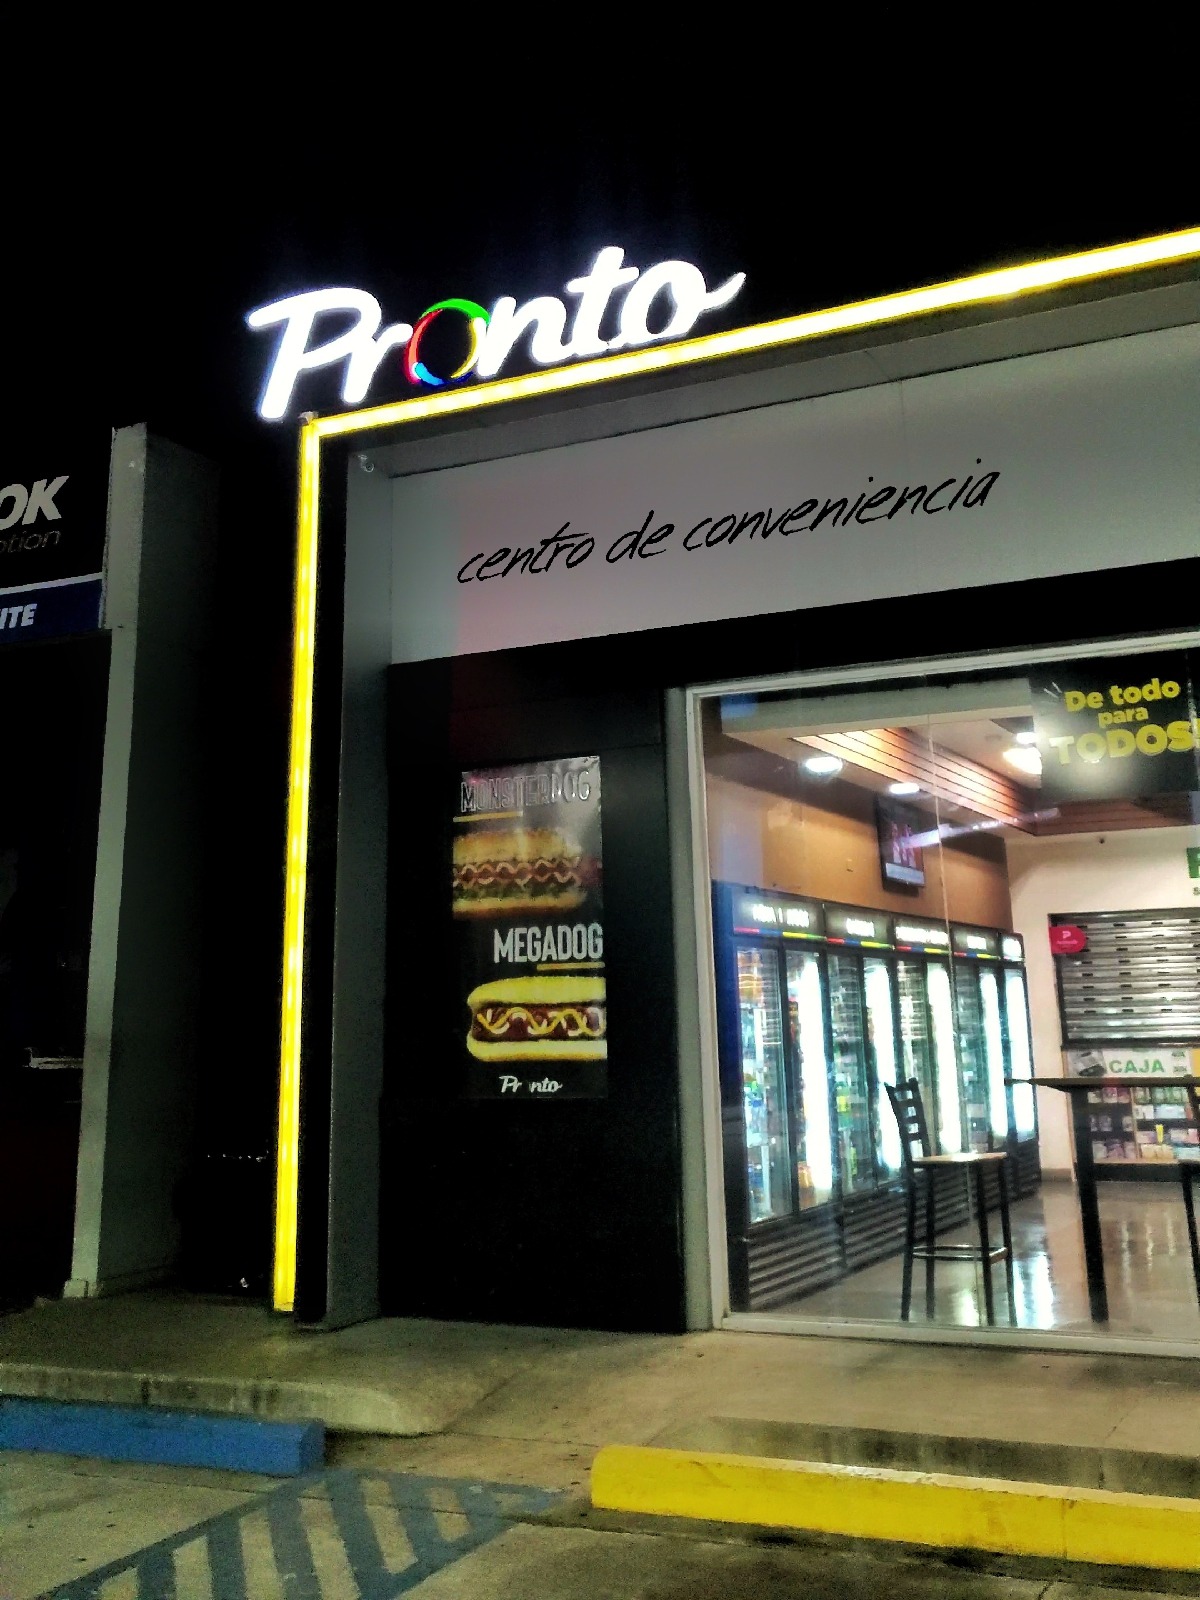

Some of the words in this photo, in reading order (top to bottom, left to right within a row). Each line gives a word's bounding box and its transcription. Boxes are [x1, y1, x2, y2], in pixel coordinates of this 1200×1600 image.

[248, 246, 746, 419] Pronto
[457, 521, 594, 583] centro
[605, 510, 675, 562] de
[682, 458, 1000, 551] conveniencia
[1065, 691, 1103, 712] De
[1110, 678, 1180, 705] todo
[1098, 707, 1149, 728] para
[493, 922, 604, 963] MEGADOG
[1109, 1060, 1165, 1073] CAJA
